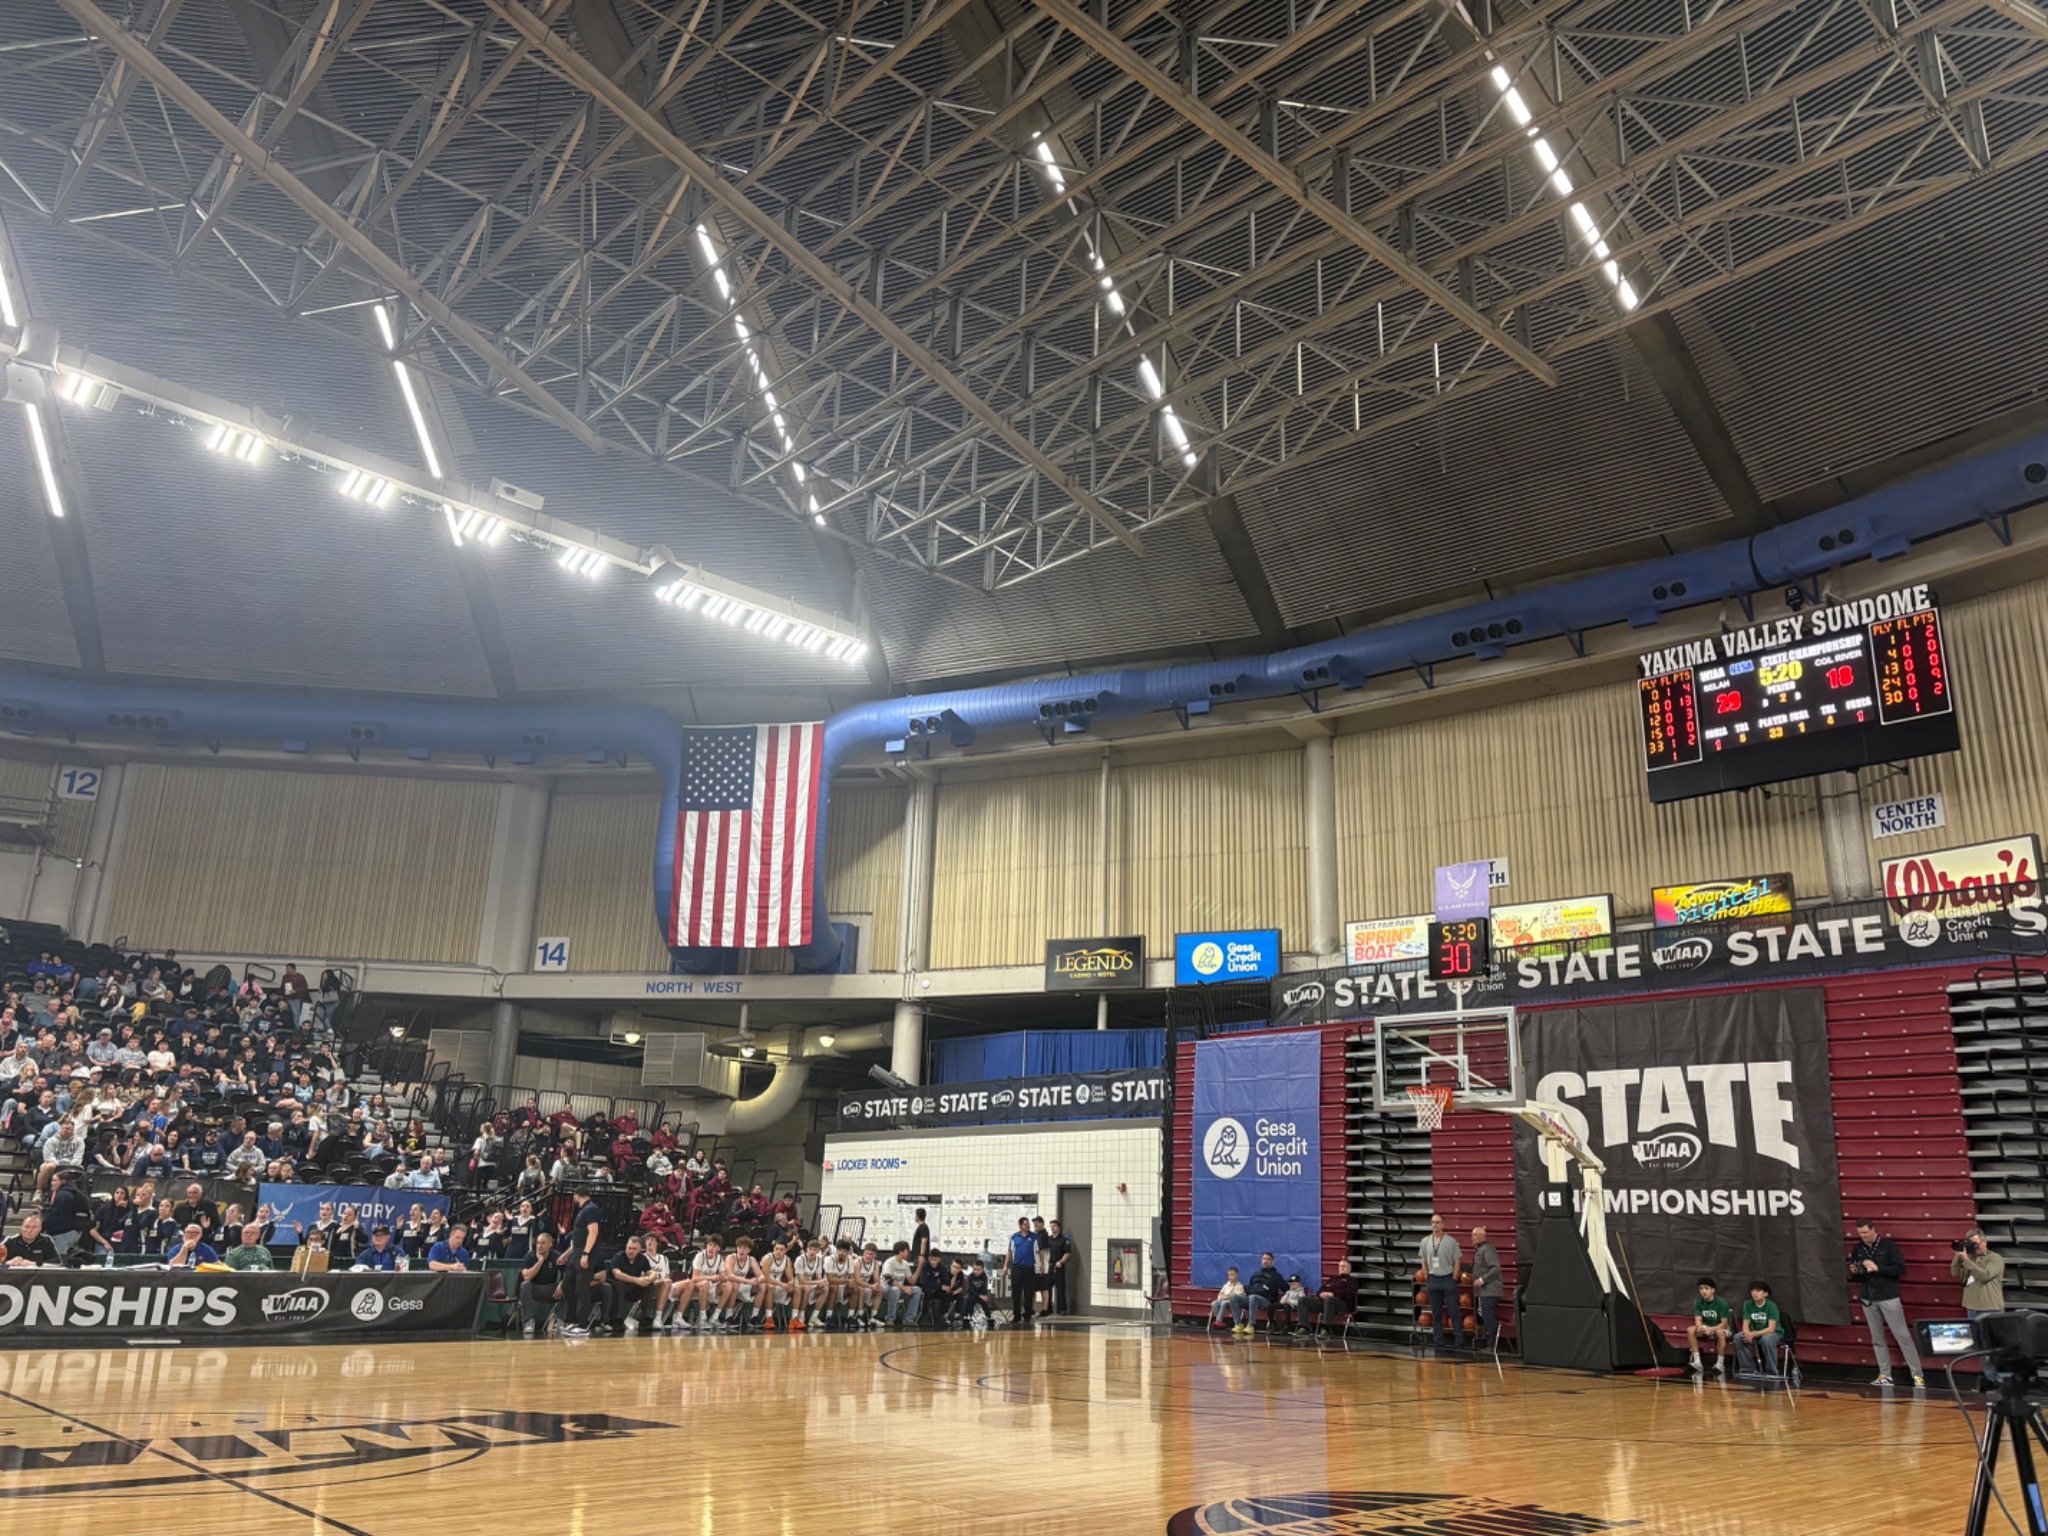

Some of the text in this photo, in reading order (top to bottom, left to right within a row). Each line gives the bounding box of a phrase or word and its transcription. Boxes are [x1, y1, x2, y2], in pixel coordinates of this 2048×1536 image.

[1640, 583, 1930, 677] YAKIMA VALLEY SUNDOME
[1873, 612, 1934, 636] PLY FL PTS
[1926, 624, 1934, 637] 2
[1788, 634, 1863, 660] CHAMPIONSHIP
[1887, 638, 1936, 658] 4 0 0
[1814, 656, 1834, 666] COL
[1884, 653, 1938, 675] 13 0 0
[1642, 679, 1657, 690] PLY
[1674, 670, 1690, 683] PTS
[1759, 660, 1803, 686] 5:20
[1882, 677, 1901, 691] 24
[1906, 672, 1916, 685] 0
[1652, 690, 1659, 700] 0
[1682, 682, 1690, 692] 4
[1885, 682, 1943, 704] 30 0 2
[1648, 695, 1692, 714] 10 0 13
[1650, 708, 1693, 726] 12 0 3
[1651, 721, 1694, 739] 15 0 0
[1649, 740, 1664, 754] 33
[1688, 734, 1696, 746] 2
[64, 770, 98, 796] 12
[1876, 798, 1937, 820] CENTER
[1880, 812, 1936, 834] NORTH
[1886, 850, 2036, 915] Wray's
[1675, 880, 1752, 910] Advanced
[1676, 879, 1771, 924] Digital
[1355, 922, 1376, 932] STATE
[1378, 921, 1394, 930] FAIR
[1395, 920, 1415, 928] PARK
[1442, 922, 1476, 942] 5:20
[1946, 916, 1992, 931] Credit
[1355, 926, 1415, 946] SPRINT
[1726, 914, 1886, 966] STATE
[538, 942, 566, 966] 14
[1227, 942, 1254, 954] Gesa
[1227, 951, 1262, 963] Credit
[1354, 944, 1396, 962] BOAT
[1441, 942, 1472, 974] 30
[1662, 945, 1703, 961] WIAA
[1054, 951, 1134, 973] LEGENDS
[1227, 962, 1258, 972] Union
[1517, 944, 1642, 989] STATE
[646, 982, 743, 994] NORTH WEST
[1334, 970, 1438, 1008] STATE
[939, 1092, 988, 1114] STATE
[1018, 1085, 1072, 1108] STATE
[864, 1097, 908, 1118] STATE
[1536, 1060, 1800, 1170] STATE
[1256, 1118, 1296, 1136] Gesa
[1256, 1136, 1308, 1156] Credit
[1643, 1142, 1692, 1158] WIAA
[838, 1158, 900, 1170] LOCKER ROOMS
[1256, 1157, 1302, 1176] Union
[272, 1297, 319, 1312] WIAA
[388, 1297, 424, 1311] Gesa
